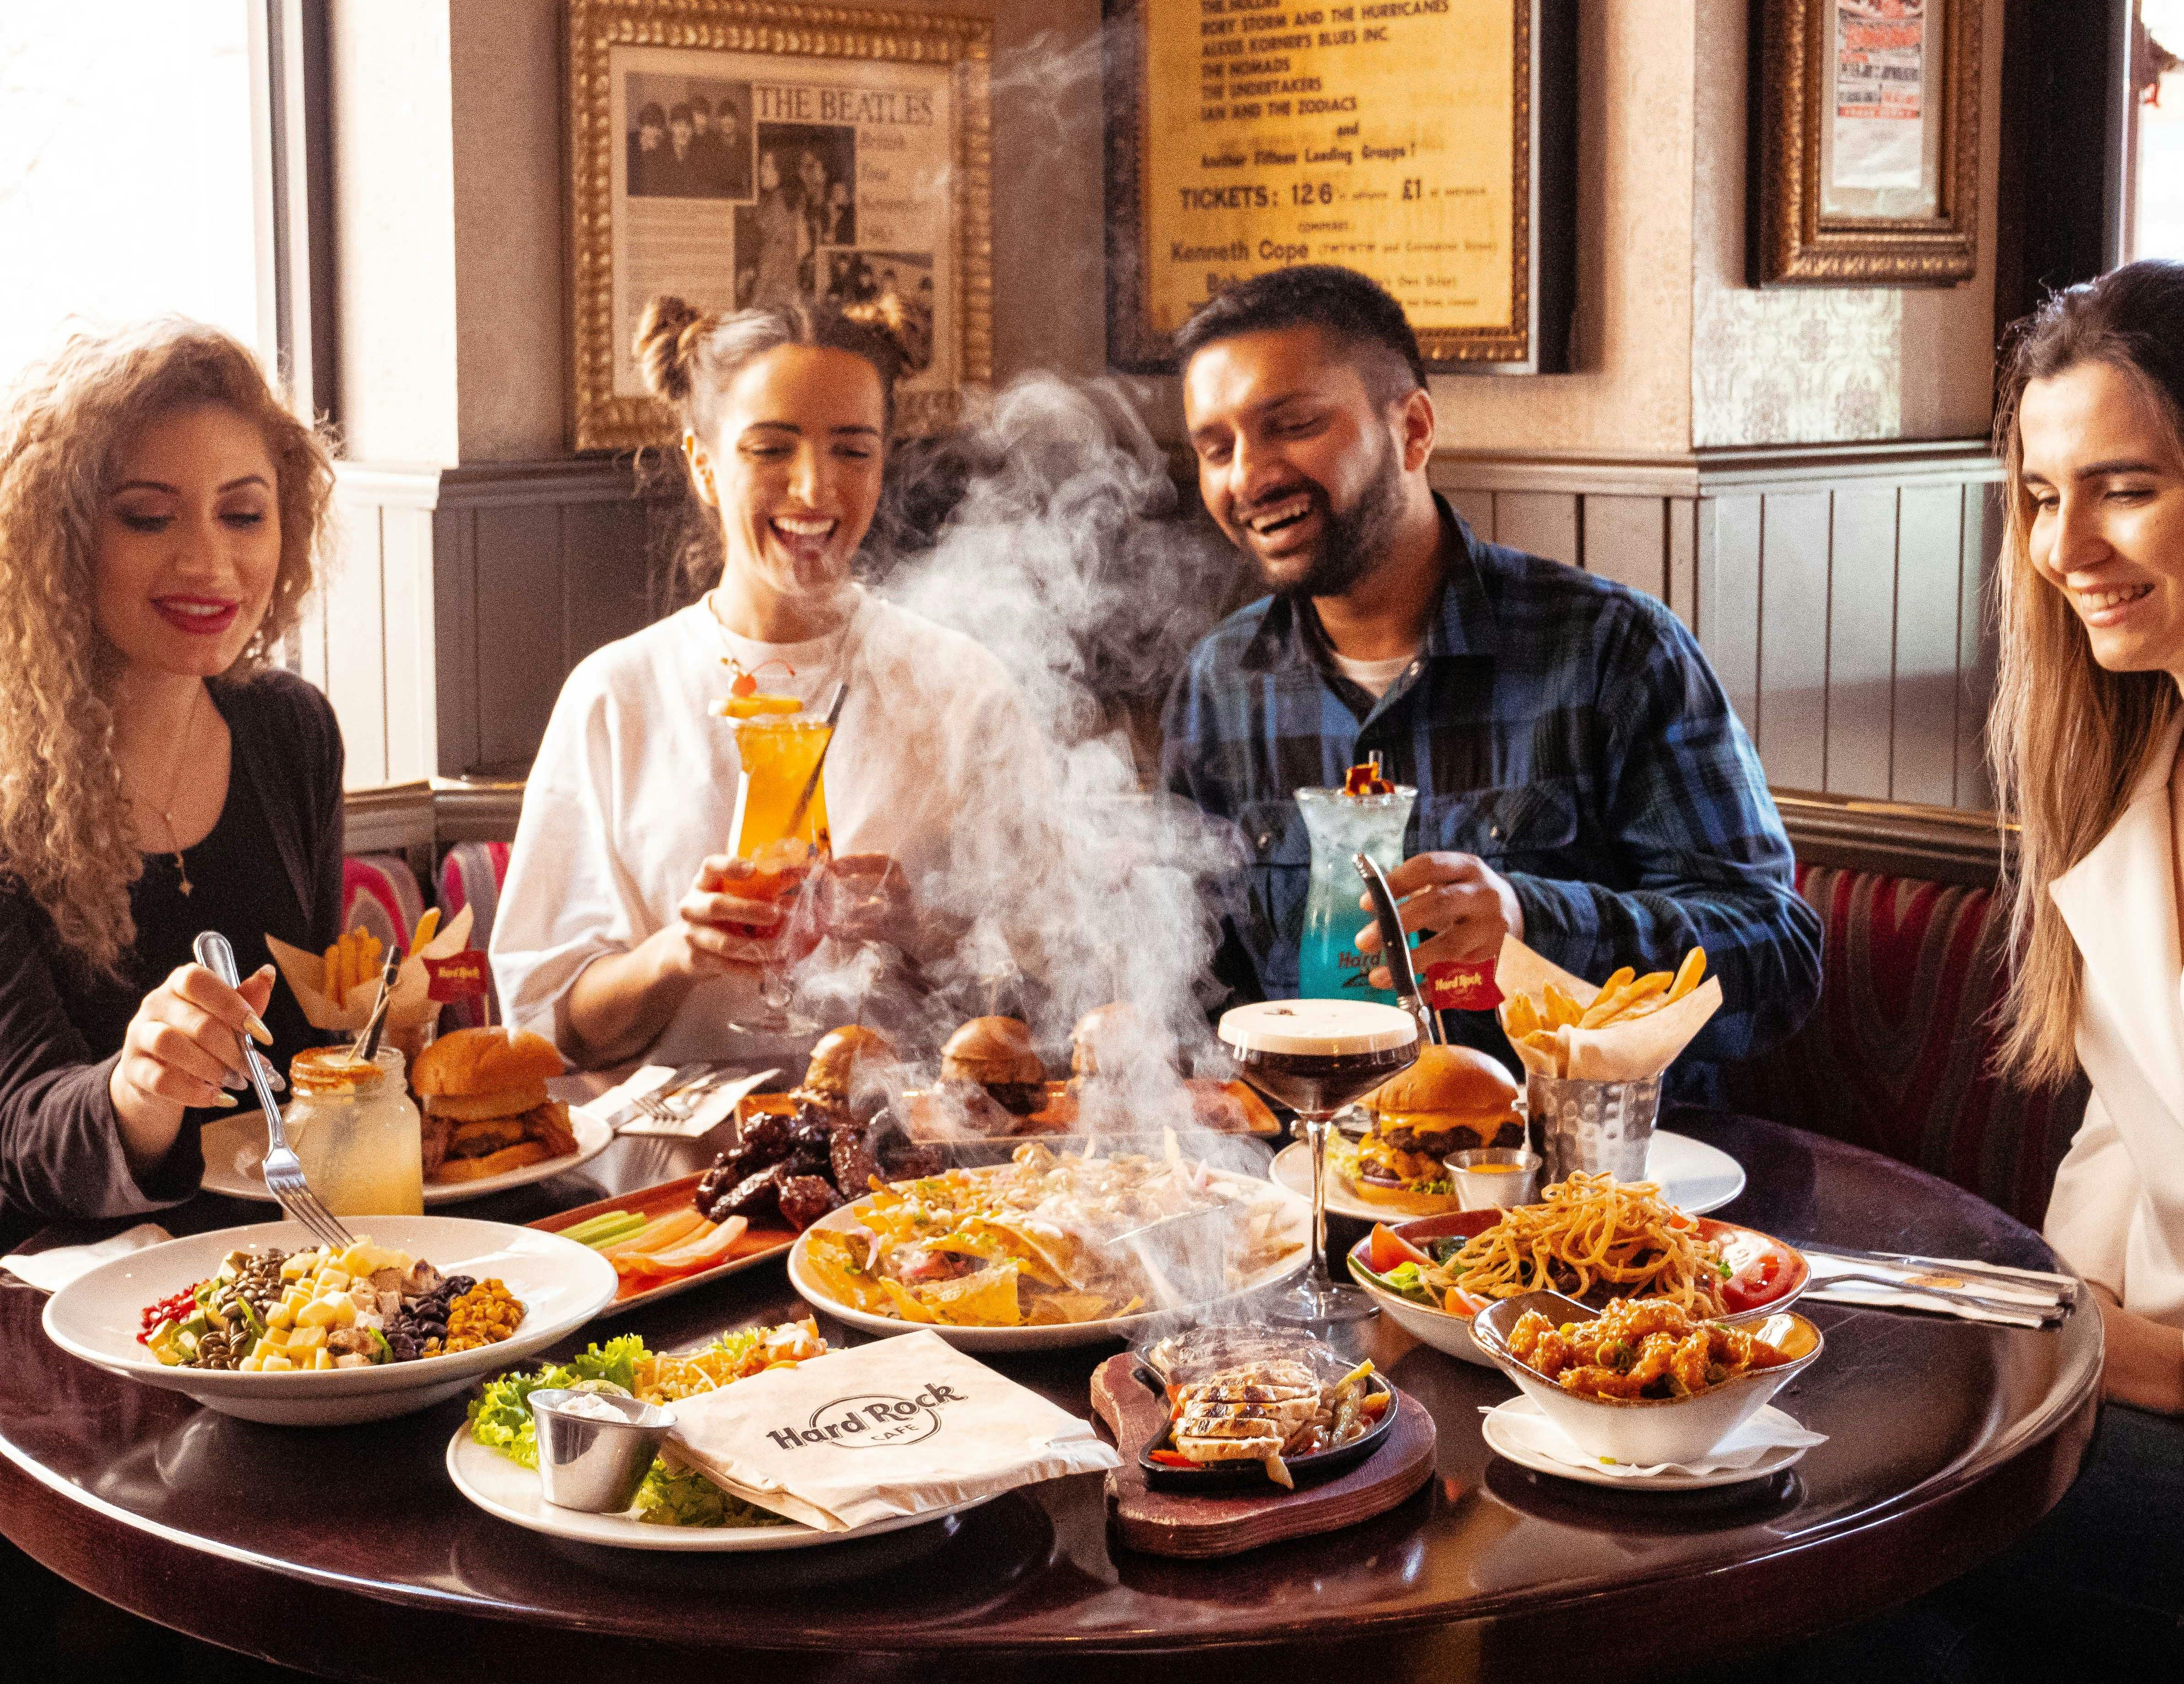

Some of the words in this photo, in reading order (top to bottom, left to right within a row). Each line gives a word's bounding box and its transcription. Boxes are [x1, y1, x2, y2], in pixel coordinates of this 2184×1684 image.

[1294, 11, 1323, 26] AND
[1332, 7, 1354, 22] THE
[1318, 30, 1356, 47] BLUES
[757, 87, 812, 120] THE
[820, 90, 934, 127] BEATLES
[1232, 103, 1261, 119] AND
[1268, 101, 1290, 116] THE
[1298, 97, 1357, 115] ZODIACS
[1170, 240, 1250, 263] Kenneth
[1258, 239, 1310, 267] Cope
[765, 1411, 871, 1450] Hard
[862, 1383, 969, 1423] Rock
[870, 1423, 920, 1443] CAFE
